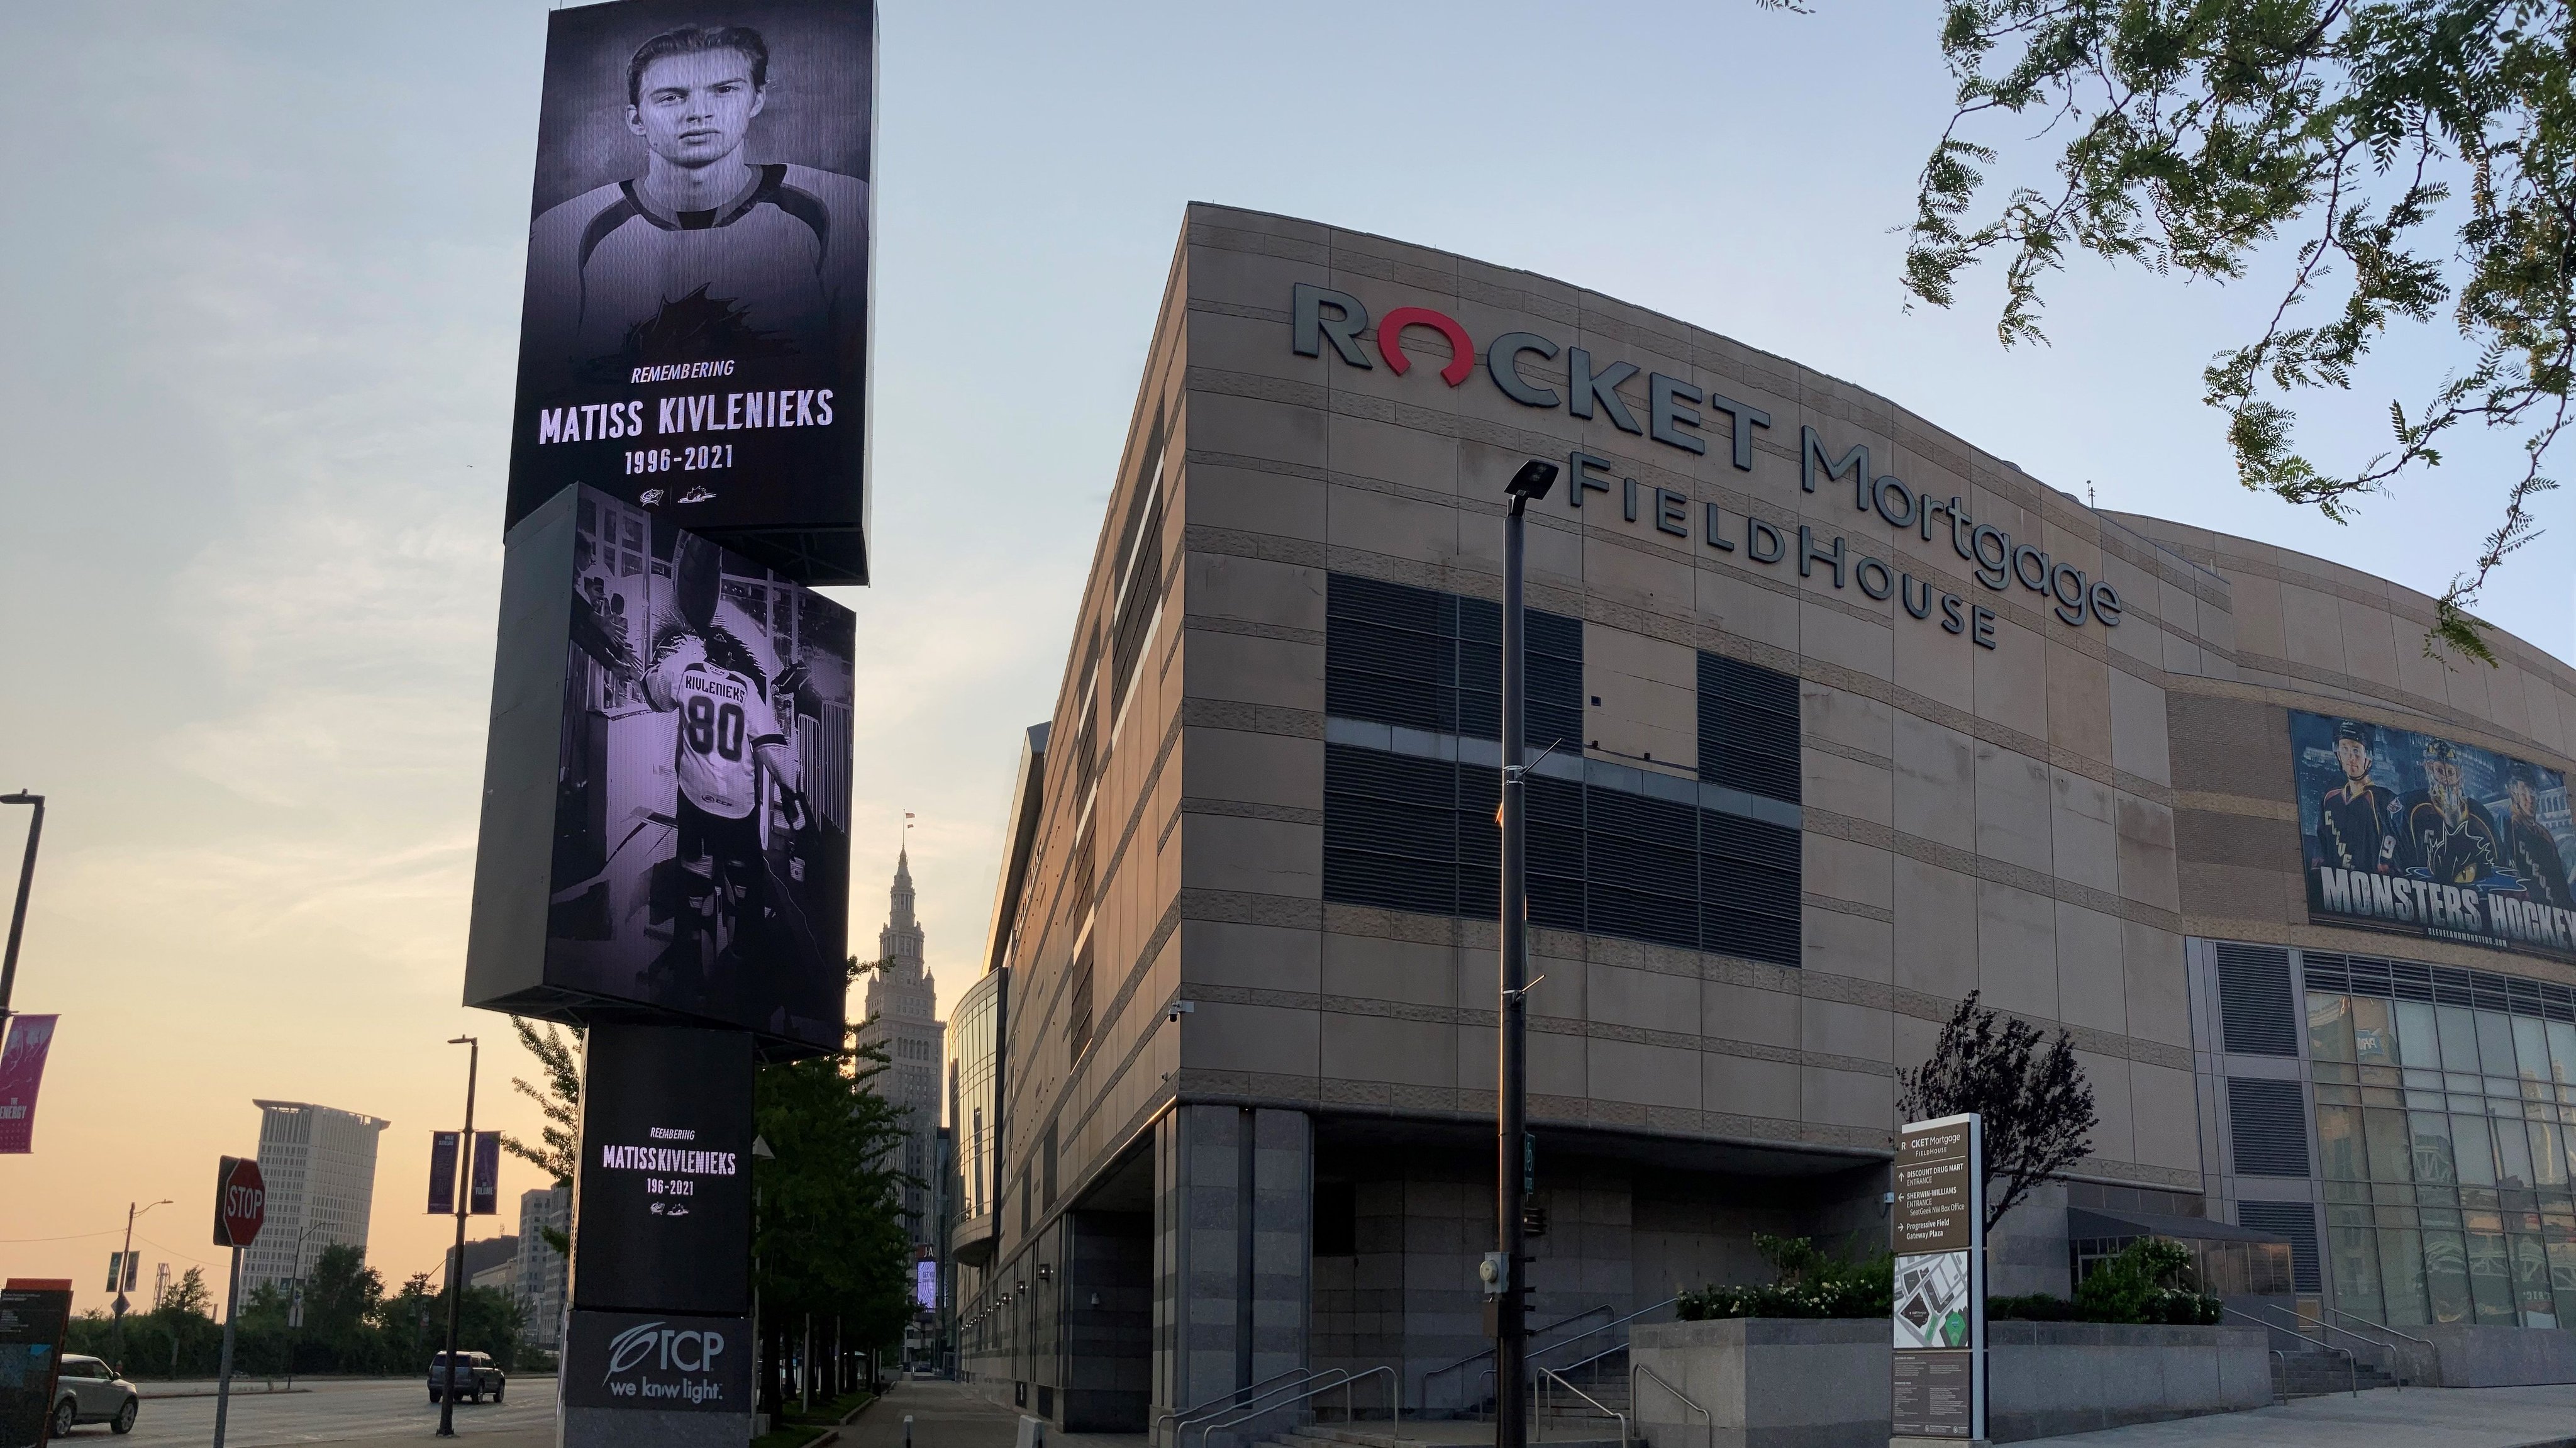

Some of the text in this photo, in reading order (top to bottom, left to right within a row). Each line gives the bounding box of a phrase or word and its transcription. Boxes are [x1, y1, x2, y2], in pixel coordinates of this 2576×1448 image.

[631, 360, 735, 384] REMEMBERING
[539, 389, 833, 445] MATISS KIVLENIEKS
[625, 444, 733, 475] 1996-2021
[1292, 282, 2122, 627] ROCKET Mortgage
[1570, 451, 1996, 649] FIELDHOUSE
[686, 675, 745, 704] KIVLENIEKS
[688, 696, 745, 763] 80
[2320, 866, 2483, 932] MONSTERS
[650, 1127, 696, 1140] REEMBERING
[1901, 1133, 1961, 1150] RCKET Mortgage
[1907, 1162, 1963, 1179] DISCOUNT DRUG MART
[647, 1178, 694, 1196] 196-2021
[1907, 1176, 1933, 1186] ENTRANCE
[228, 1184, 263, 1219] STOP
[1907, 1186, 1957, 1200] SHERWIN-WILLIAMS
[1907, 1198, 1932, 1208] ENTRANCE
[1910, 1206, 1931, 1217] SeatGeek
[1941, 1205, 1950, 1213] Box
[1950, 1203, 1965, 1211] Office
[1906, 1218, 1950, 1231] Progressive Field
[1906, 1230, 1943, 1240] Gateway Plaza
[660, 1330, 724, 1372] TCP
[610, 1382, 636, 1396] we
